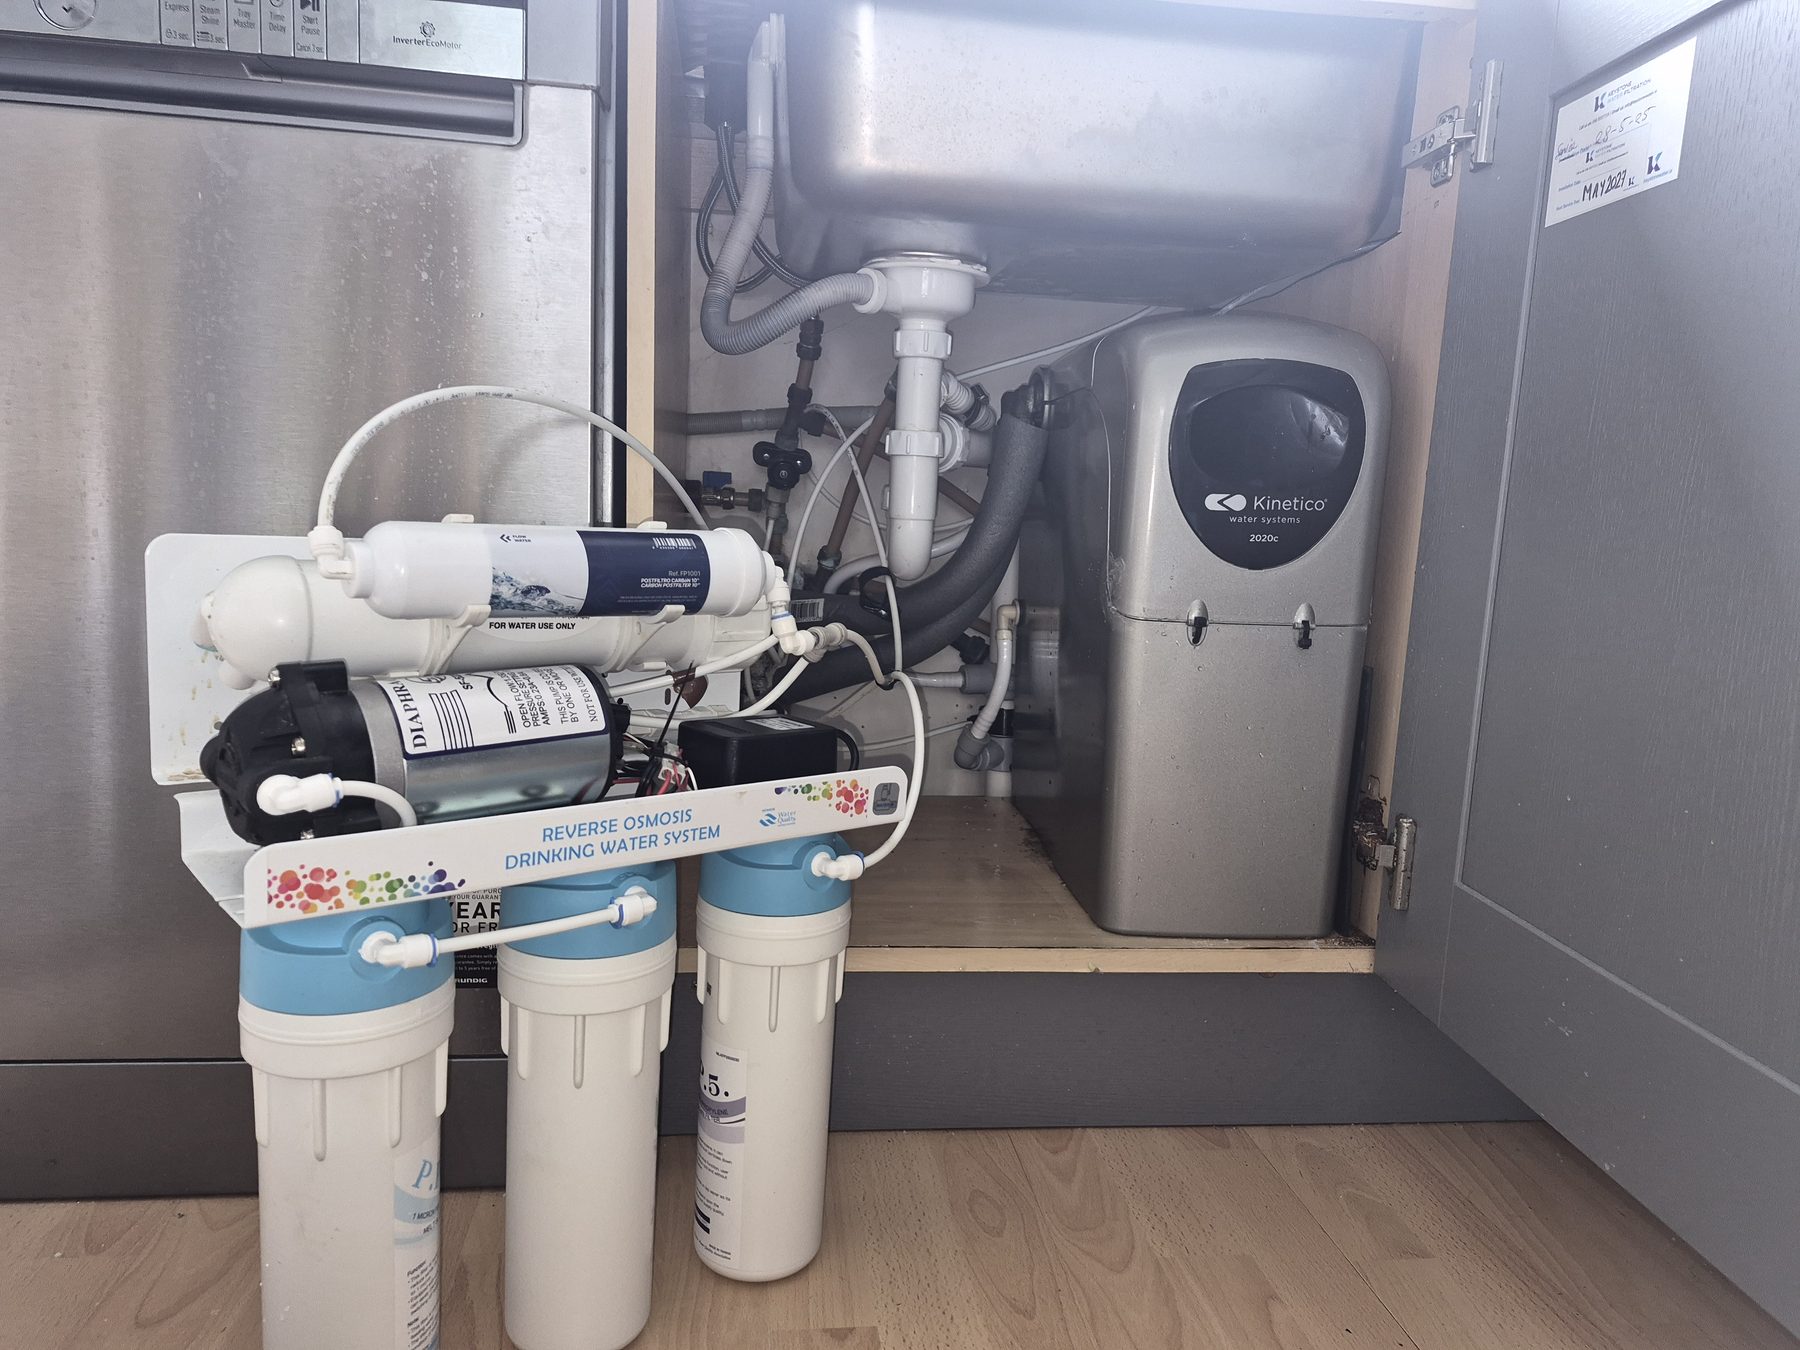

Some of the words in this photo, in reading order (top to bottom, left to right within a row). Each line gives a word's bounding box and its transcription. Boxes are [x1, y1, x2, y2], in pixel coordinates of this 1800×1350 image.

[164, 2, 190, 12] Express
[392, 35, 462, 49] InverterEcoMotor
[1229, 515, 1257, 523] water
[1261, 515, 1301, 524] systems
[1249, 534, 1279, 543] 2020c
[489, 622, 506, 630] FOR
[508, 622, 536, 630] WATER
[538, 622, 554, 630] USE
[555, 622, 576, 630] ONLY
[556, 681, 567, 691] OR
[549, 687, 564, 704] PUMP
[562, 692, 574, 708] ONE
[580, 688, 592, 702] FOR
[517, 703, 531, 728] OPEN
[522, 689, 541, 727] PRESSURE
[557, 706, 569, 724] THIS
[586, 704, 598, 722] NOT
[570, 711, 579, 723] BY
[542, 818, 618, 842] REVERSE
[623, 808, 693, 831] OSMOSIS
[505, 843, 594, 870] DRINKING
[600, 834, 658, 856] WATER
[664, 824, 721, 846] SYSTEM
